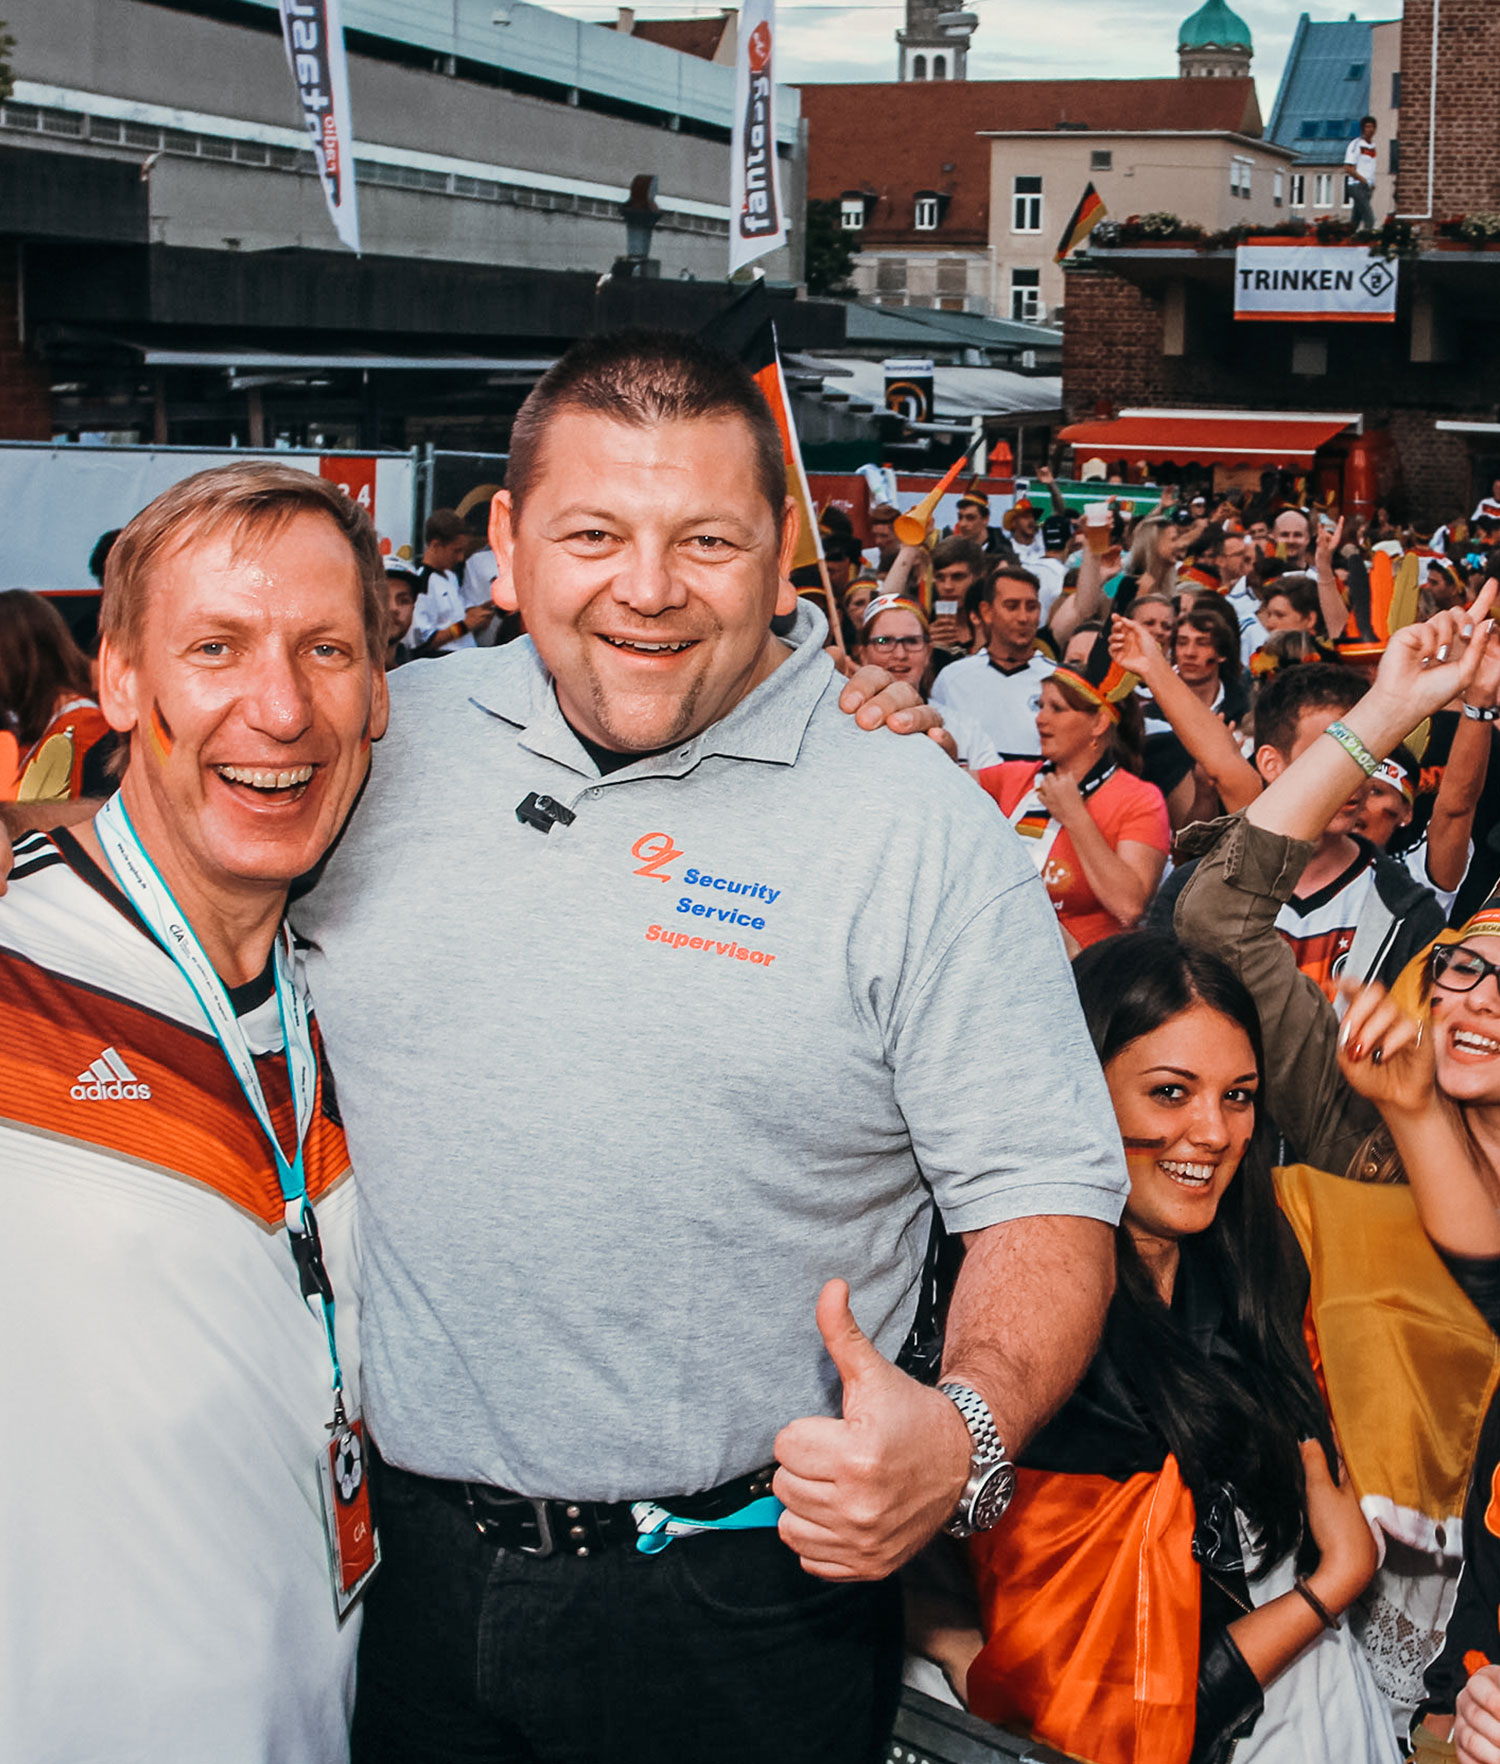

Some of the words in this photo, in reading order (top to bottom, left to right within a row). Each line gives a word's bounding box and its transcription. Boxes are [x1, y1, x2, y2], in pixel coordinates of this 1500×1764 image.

[1239, 269, 1353, 291] TRINKEN
[683, 868, 782, 905] Security
[675, 897, 766, 930] Service
[645, 924, 776, 967] Supervisor
[70, 1080, 152, 1101] adidas
